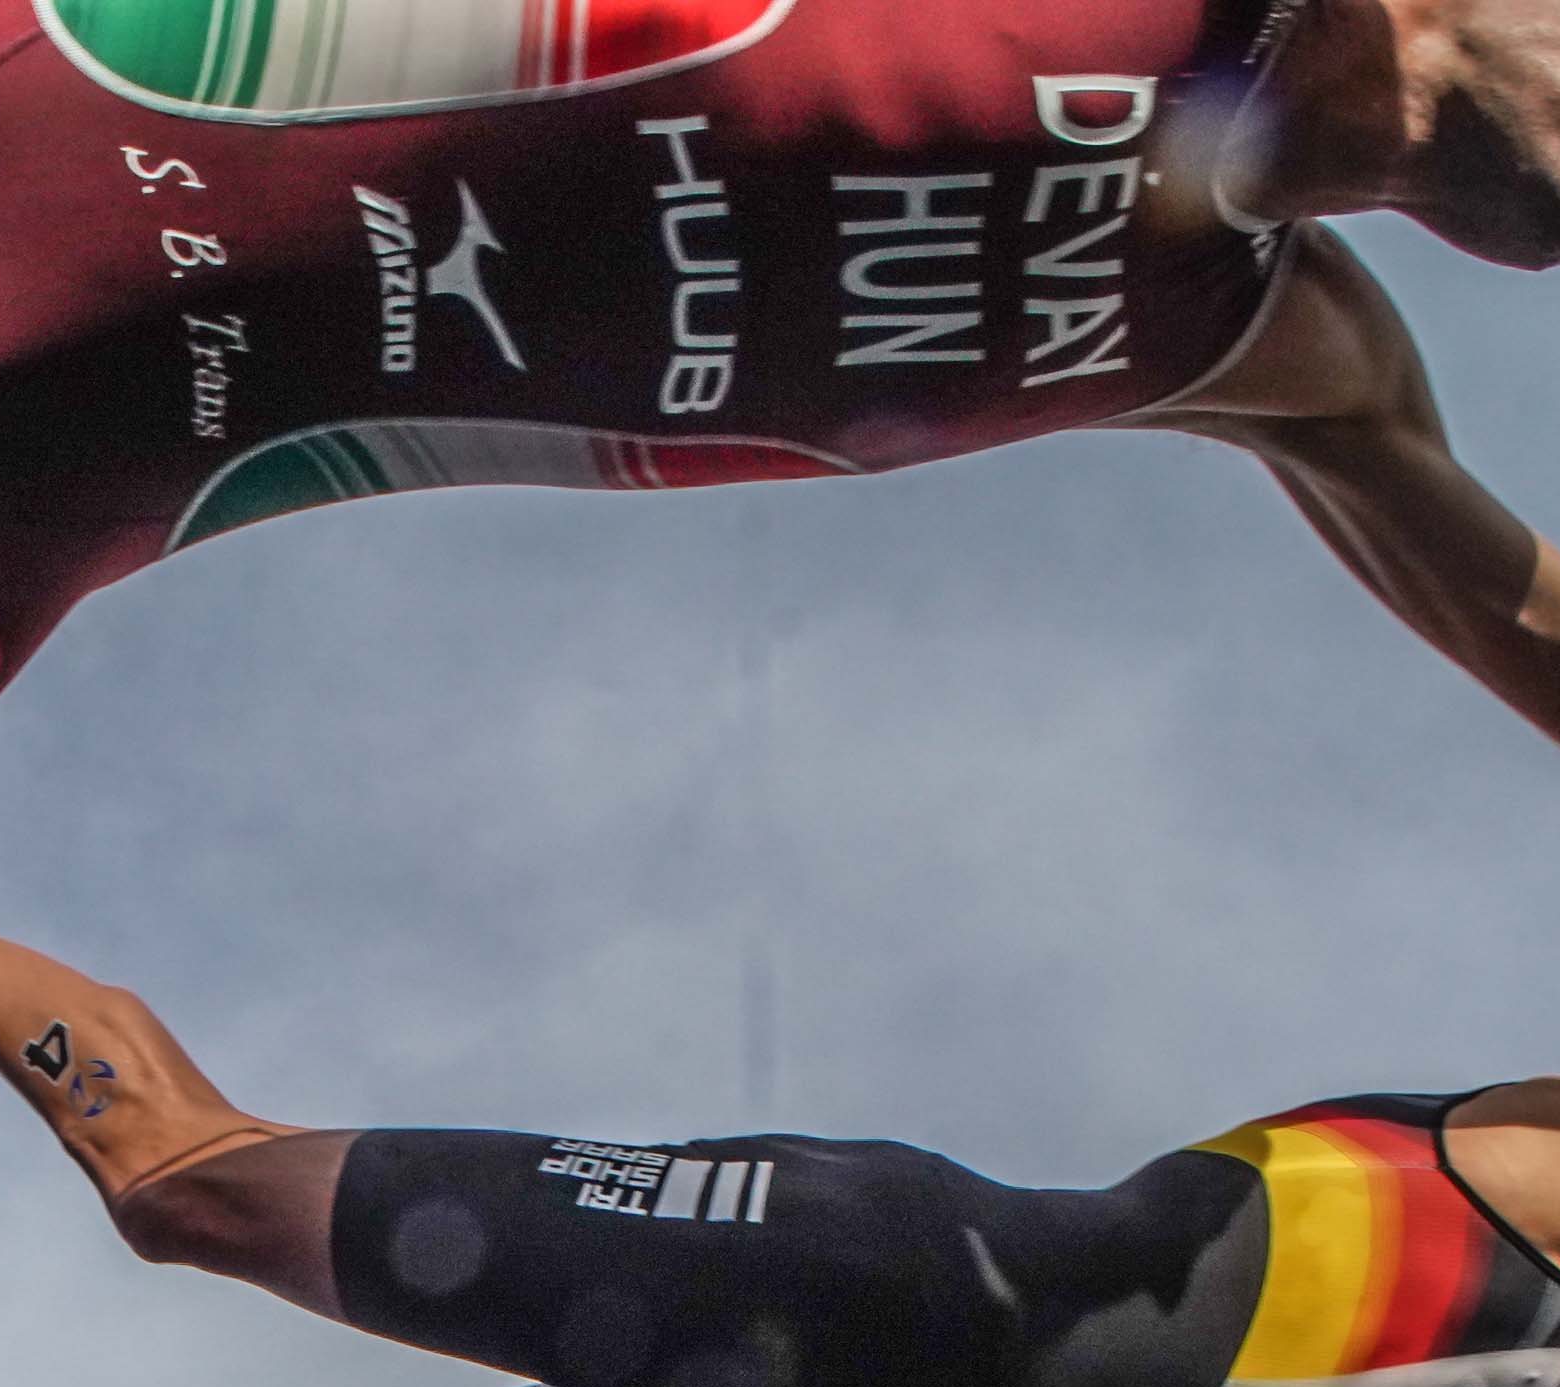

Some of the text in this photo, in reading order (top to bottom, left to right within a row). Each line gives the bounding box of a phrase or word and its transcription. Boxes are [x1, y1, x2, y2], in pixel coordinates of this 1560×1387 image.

[635, 115, 741, 414] HUUB
[832, 172, 993, 366] HUN
[537, 1154, 662, 1189] SHOP
[576, 1183, 648, 1217] TRI
